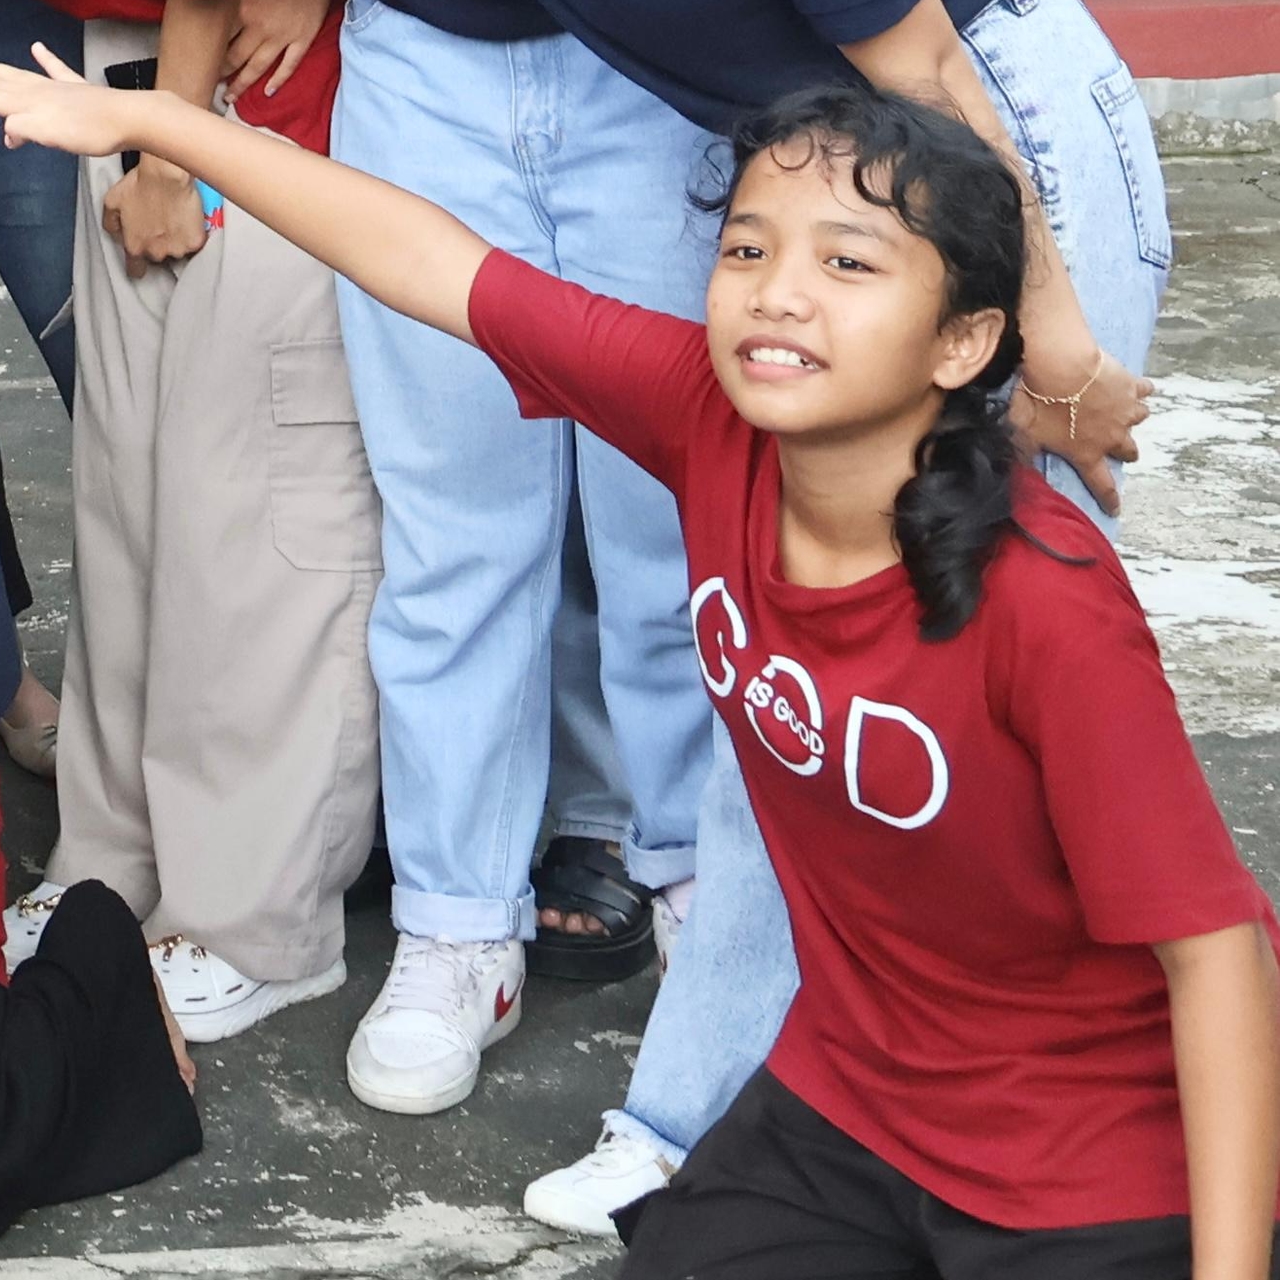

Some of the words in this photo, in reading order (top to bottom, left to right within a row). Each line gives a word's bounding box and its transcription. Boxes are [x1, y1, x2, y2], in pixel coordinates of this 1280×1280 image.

[690, 576, 949, 830] GOD
[744, 676, 774, 708] IS
[773, 696, 825, 756] GOOD
